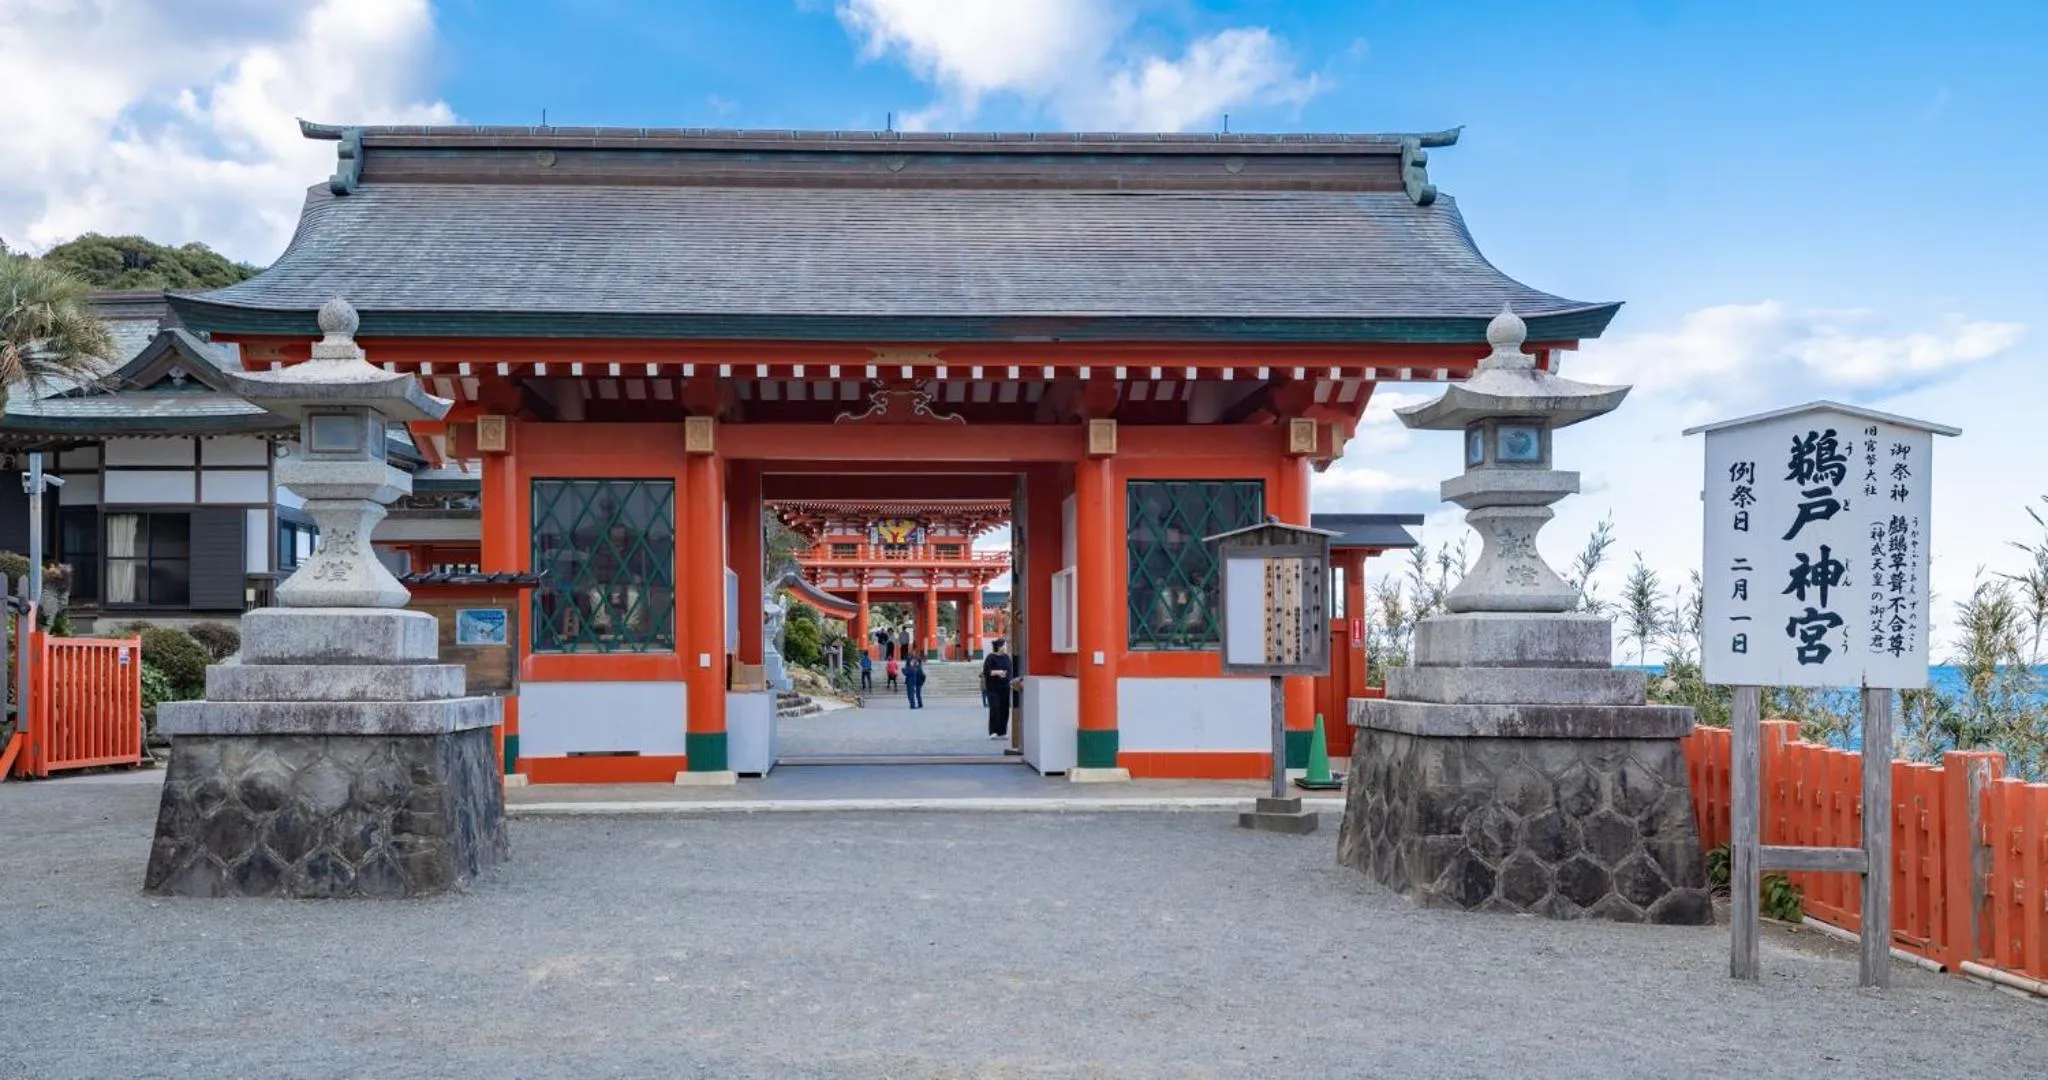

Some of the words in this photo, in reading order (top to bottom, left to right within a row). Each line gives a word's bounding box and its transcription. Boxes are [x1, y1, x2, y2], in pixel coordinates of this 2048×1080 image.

[1729, 461, 1757, 532] 例祭日
[1889, 442, 1912, 503] 御祭神
[1781, 428, 1848, 666] 鵜戸神宮
[1729, 558, 1754, 654] 二月一日
